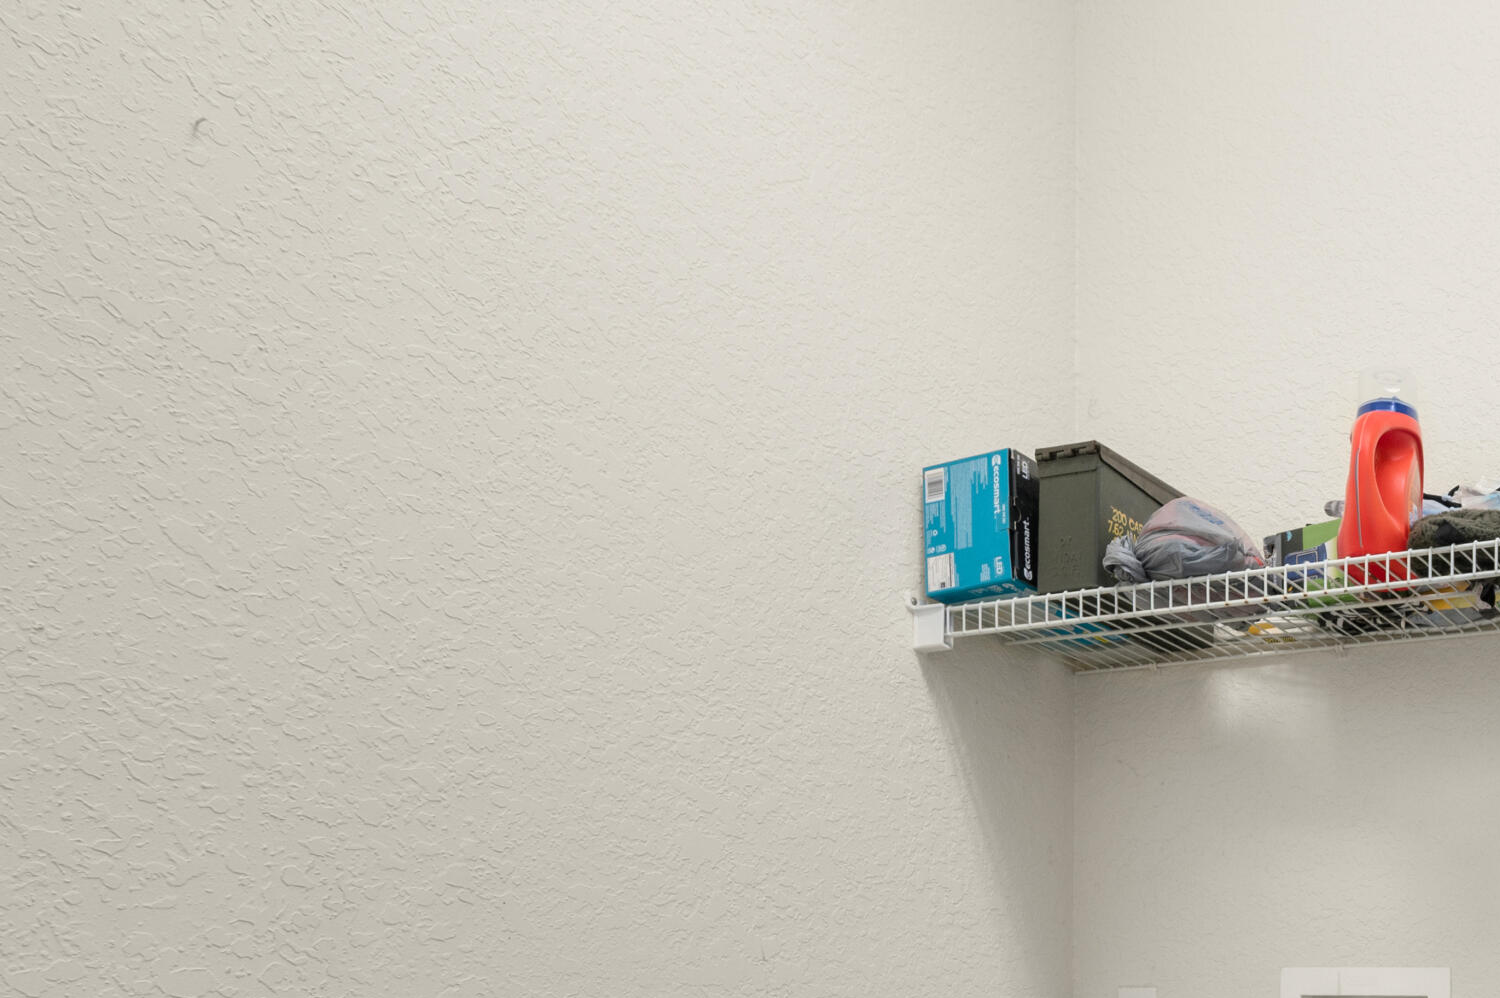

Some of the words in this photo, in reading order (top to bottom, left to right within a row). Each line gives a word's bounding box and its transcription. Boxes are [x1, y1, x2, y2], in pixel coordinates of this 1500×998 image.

[1022, 461, 1030, 480] LED
[992, 463, 1001, 514] ecosmart
[1022, 519, 1032, 570] ecosmart
[994, 556, 1003, 575] LED
